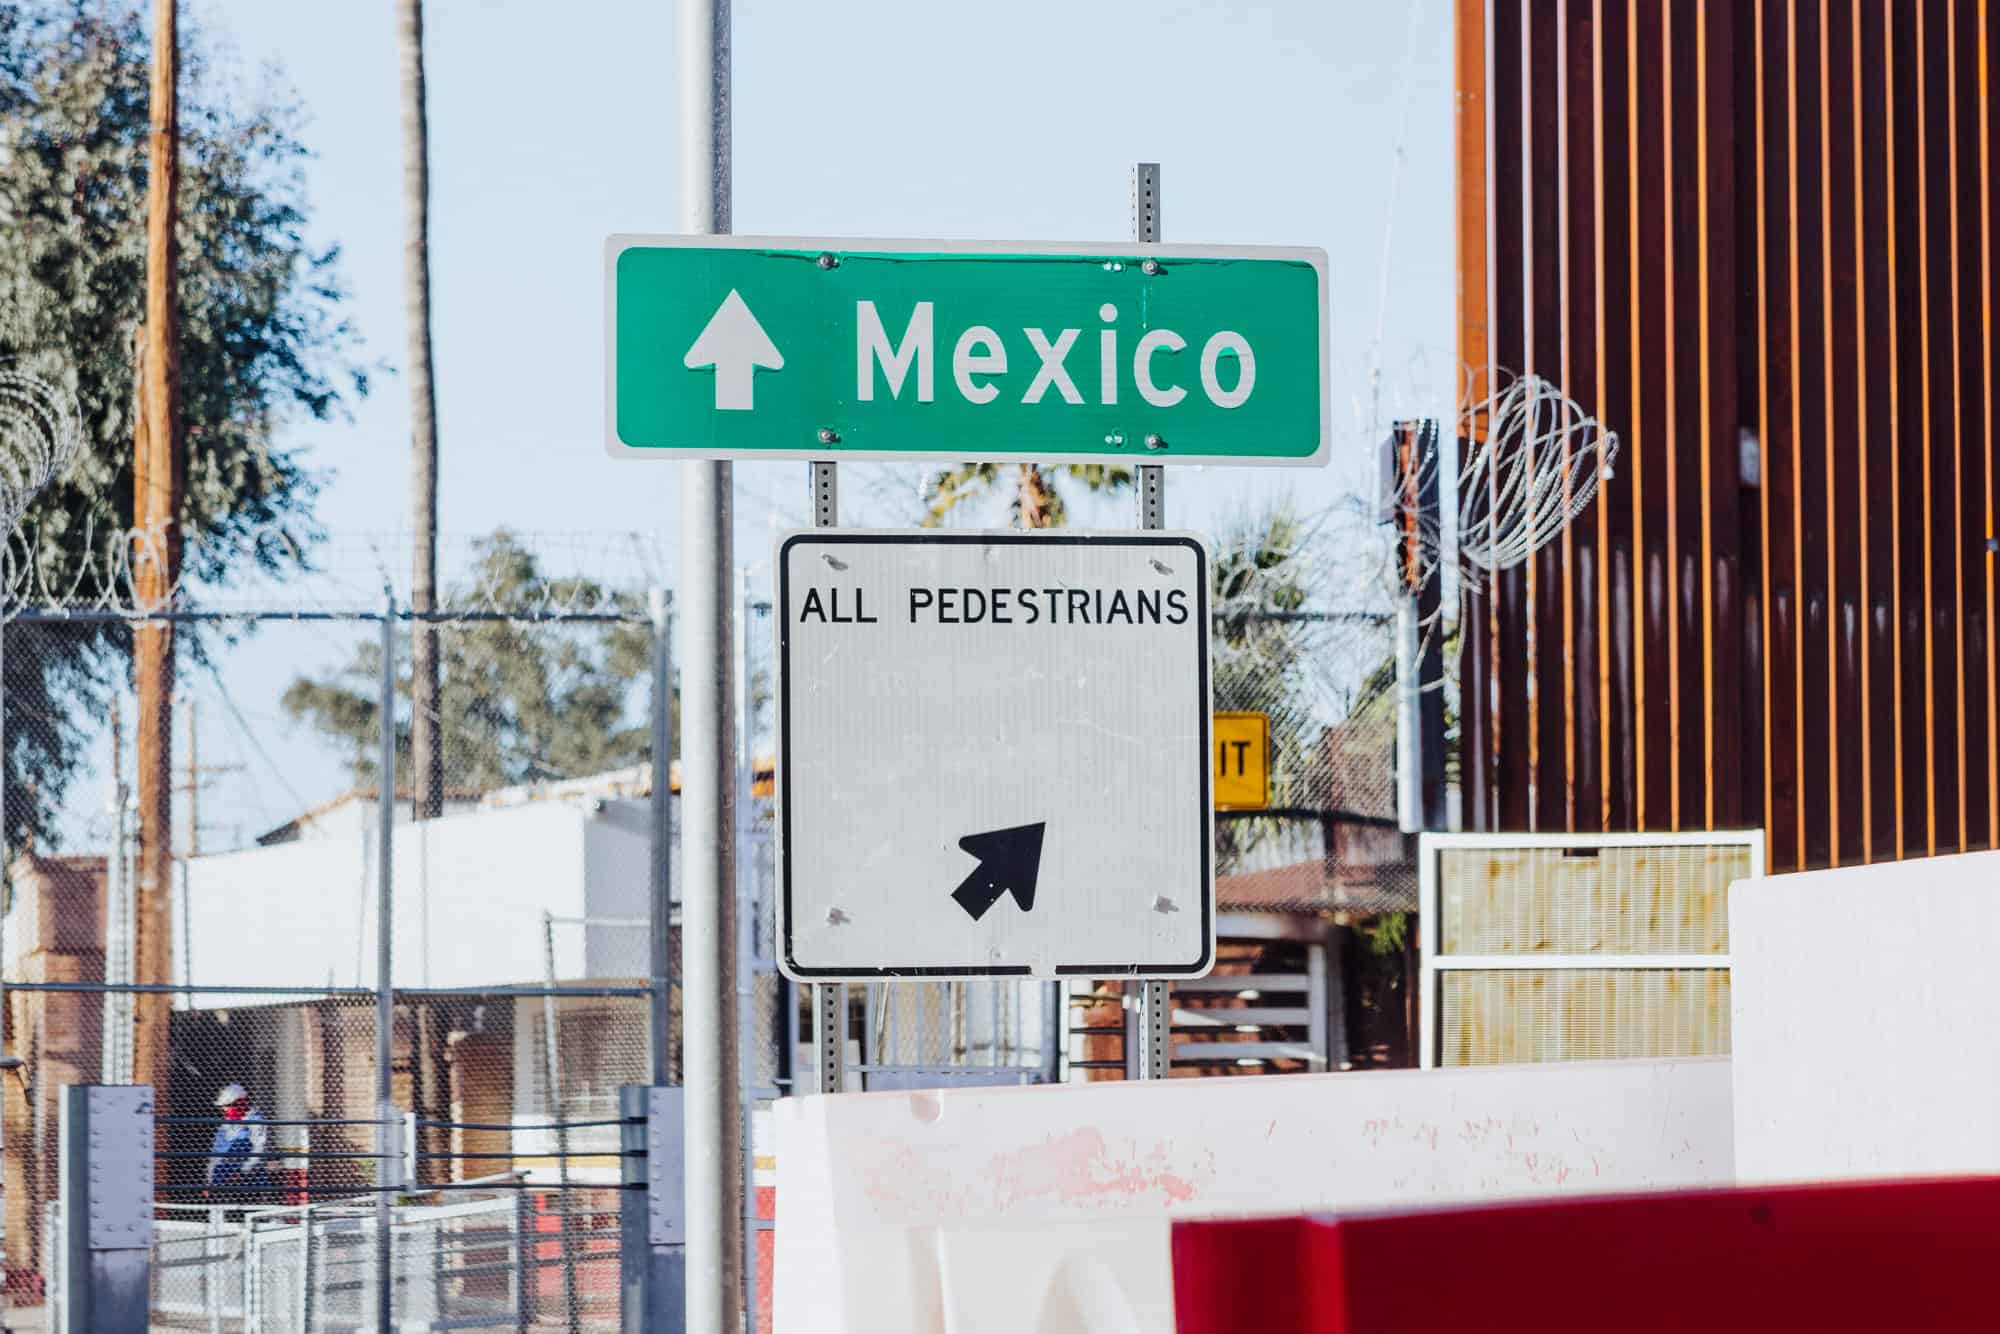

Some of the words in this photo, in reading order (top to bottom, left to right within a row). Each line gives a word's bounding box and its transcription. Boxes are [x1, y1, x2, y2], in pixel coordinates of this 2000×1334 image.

[857, 301, 1256, 409] Mexico
[799, 587, 878, 624] ALL
[909, 588, 1189, 625] PEDESTRIANS
[1219, 740, 1252, 778] IT
